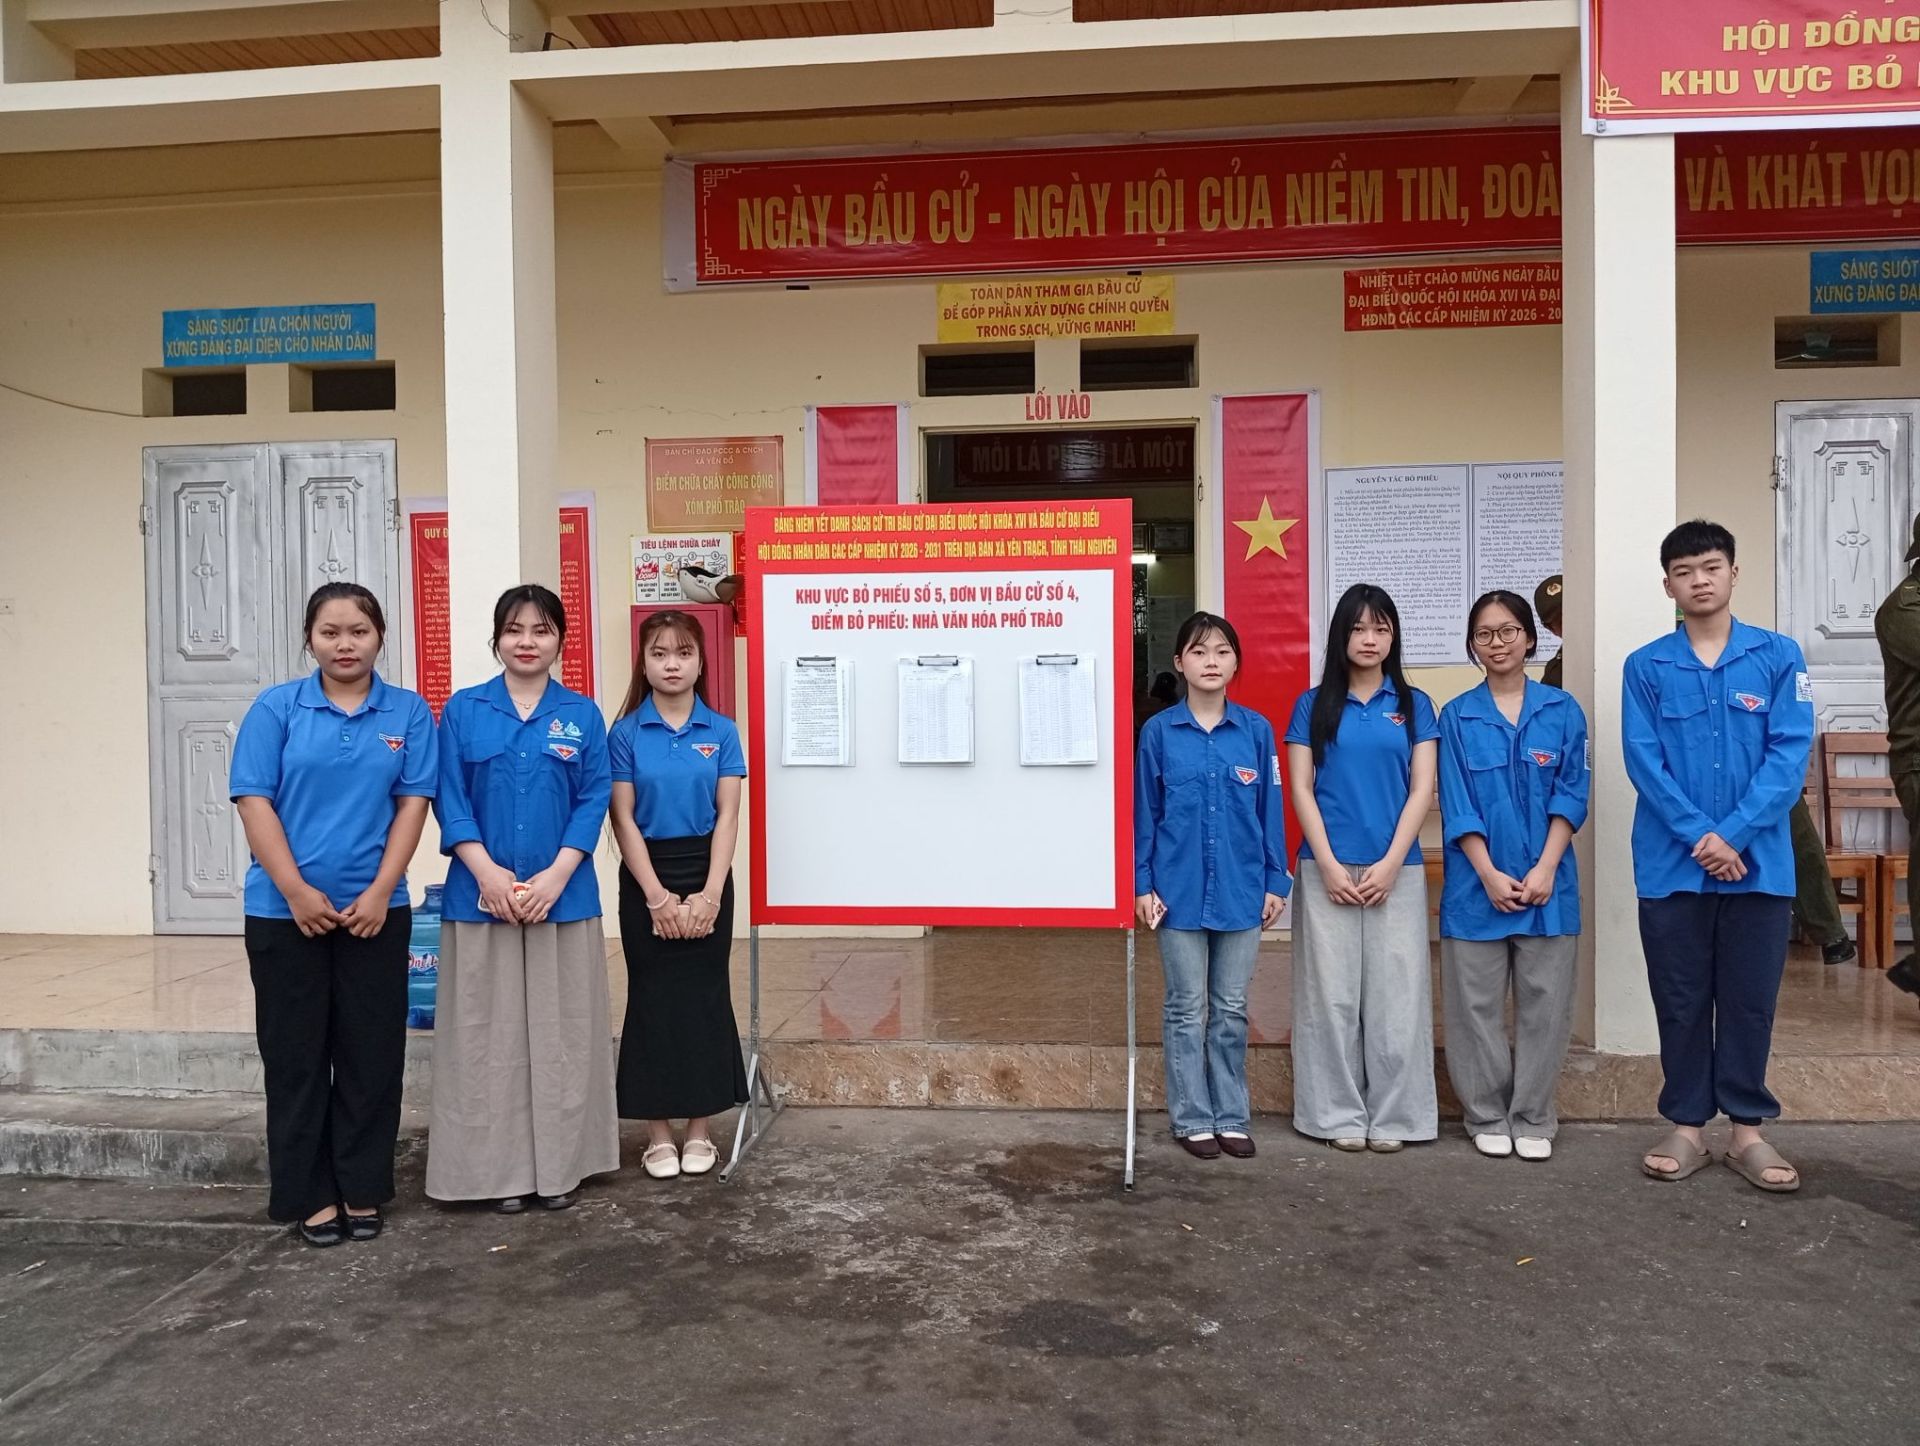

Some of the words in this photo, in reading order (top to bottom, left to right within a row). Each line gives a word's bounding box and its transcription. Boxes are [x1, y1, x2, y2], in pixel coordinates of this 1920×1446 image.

[1722, 18, 1789, 55] HỘI
[1804, 10, 1920, 47] ĐỒNG
[1661, 70, 1740, 95] KHU
[1754, 65, 1832, 98] VỰC
[1848, 54, 1902, 90] BỎ
[1684, 145, 1734, 211] VÀ
[1747, 141, 1847, 210] KHÁT
[738, 184, 832, 250] NGÀY
[844, 173, 915, 246] BẦU
[928, 170, 979, 244] CỬ
[988, 212, 1000, 224] -
[1013, 172, 1111, 240] NGÀY
[1124, 168, 1185, 246] HỘI
[1199, 157, 1273, 231] CỦA
[1286, 152, 1383, 227] NIỀM
[1397, 166, 1469, 226] TIN,
[1482, 151, 1560, 218] ĐOÀ
[1359, 272, 1394, 290] NHIỆT
[1398, 270, 1420, 289] LIỆT
[1424, 269, 1458, 285] CHÀO
[1461, 267, 1500, 284] MỪNG
[1503, 267, 1534, 282] NGÀY
[1536, 264, 1559, 282] BẦU
[1841, 258, 1878, 279] SÁNG
[1882, 256, 1919, 279] SUỐT
[971, 284, 1003, 301] TOÀN
[1007, 283, 1032, 299] DÂN
[1035, 284, 1071, 298] THAM
[1074, 283, 1095, 297] GIA
[1098, 278, 1121, 296] BẦU
[1125, 277, 1142, 294] CỬ
[1349, 295, 1369, 311] ĐẠI
[1373, 289, 1399, 306] BIỂU
[1402, 287, 1435, 305] QUỐC
[1438, 288, 1459, 307] HỘI
[1463, 287, 1496, 303] KHÓA
[1500, 289, 1518, 302] XVI
[1521, 285, 1537, 301] VÀ
[1539, 288, 1560, 304] ĐẠI
[1814, 281, 1853, 304] XỨNG
[1857, 280, 1895, 302] ĐÁNG
[943, 302, 959, 320] ĐỂ
[961, 303, 985, 320] GÓP
[988, 299, 1021, 319] PHẦN
[1024, 301, 1047, 317] XÂY
[1051, 302, 1085, 319] DỰNG
[1088, 298, 1126, 315] CHÍNH
[1129, 295, 1169, 315] QUYỀN
[1361, 313, 1396, 327] HĐND
[1400, 307, 1422, 324] CÁC
[1424, 306, 1448, 323] CẤP
[1450, 306, 1490, 326] NHIỆM
[1492, 305, 1508, 321] KỲ
[1509, 308, 1537, 321] 2026
[187, 315, 217, 336] SÁNG
[220, 314, 250, 334] SUỐT
[253, 317, 277, 336] LỰA
[279, 316, 311, 335] CHỌN
[313, 310, 352, 331] NGƯỜI
[976, 324, 1016, 338] TRONG
[1019, 322, 1053, 339] SẠCH,
[1057, 319, 1091, 335] VỮNG
[1094, 319, 1136, 337] MẠNH!
[166, 336, 198, 358] XỨNG
[201, 337, 231, 356] ĐÁNG
[234, 338, 253, 359] ĐẠI
[256, 335, 282, 358] DIỆN
[285, 336, 309, 353] CHO
[311, 332, 343, 352] NHÂN
[346, 332, 373, 351] DÂN!
[1025, 387, 1051, 421] LỐI
[1056, 389, 1091, 420] VÀO
[713, 447, 734, 455] PCCC
[742, 446, 763, 454] CNCH
[972, 436, 1010, 473] MỖI
[1017, 440, 1041, 472] LÁ
[1111, 436, 1136, 469] LÀ
[1142, 435, 1186, 473] MỘT
[656, 471, 677, 491] ĐIỂM
[680, 473, 700, 491] CHỮA
[703, 471, 724, 490] CHÁY
[726, 472, 749, 489] CÔNG
[751, 471, 773, 492] CỘNG
[1512, 472, 1529, 480] QUY
[685, 497, 704, 515] XÓM
[706, 495, 722, 514] PHỐ
[724, 497, 745, 513] TRÀO
[774, 512, 794, 533] BẢNG
[795, 514, 814, 533] NIÊM
[816, 512, 829, 533] YẾT
[830, 516, 850, 532] DANH
[851, 512, 871, 531] SÁCH
[873, 510, 883, 531] CỬ
[884, 515, 896, 531] TRI
[897, 510, 912, 531] BẦU
[913, 510, 924, 531] CỬ
[939, 508, 956, 530] BIỂU
[958, 508, 977, 532] QUỐC
[979, 510, 991, 533] HỘI
[993, 509, 1013, 529] KHÓA
[1014, 513, 1026, 529] XVI
[1028, 509, 1037, 528] VÀ
[1039, 507, 1054, 528] BẦU
[1056, 507, 1068, 528] CỬ
[1082, 504, 1099, 528] BIỂU
[424, 527, 441, 540] QUY
[640, 540, 656, 550] TIÊU
[658, 540, 677, 551] LỆNH
[680, 538, 699, 548] CHỮA
[701, 538, 720, 548] CHÁY
[758, 541, 770, 563] HỘI
[771, 539, 792, 560] ĐỒNG
[793, 541, 814, 560] NHÂN
[815, 541, 830, 559] DÂN
[831, 540, 846, 559] CÁC
[847, 538, 862, 559] CẤP
[864, 540, 888, 562] NHIỆM
[900, 542, 918, 558] 2026
[924, 542, 941, 558] 2031
[944, 538, 962, 558] TRÊN
[978, 538, 993, 558] BÀN
[1007, 537, 1021, 557] YÊN
[1050, 534, 1067, 556] TỈNH
[1069, 536, 1086, 555] THÁI
[1087, 536, 1117, 555] NGUYÊN
[796, 588, 821, 604] KHU
[825, 586, 849, 607] VỰC
[853, 583, 869, 604] BỎ
[873, 582, 910, 603] PHIẾU
[914, 581, 931, 603] SỐ
[934, 587, 946, 605] 5,
[950, 585, 976, 602] ĐƠN
[980, 586, 992, 605] VỊ
[996, 580, 1021, 601] BẦU
[1025, 580, 1044, 601] CỬ
[1046, 580, 1064, 601] SỐ
[1067, 585, 1079, 603] 4,
[811, 608, 844, 630] ĐIỂM
[847, 609, 864, 630] BỎ
[868, 608, 909, 629] PHIẾU:
[912, 610, 939, 629] NHÀ
[942, 610, 968, 628] VĂN
[971, 609, 997, 628] HÓA
[1001, 606, 1026, 628] PHỐ
[1030, 608, 1063, 628] TRÀO
